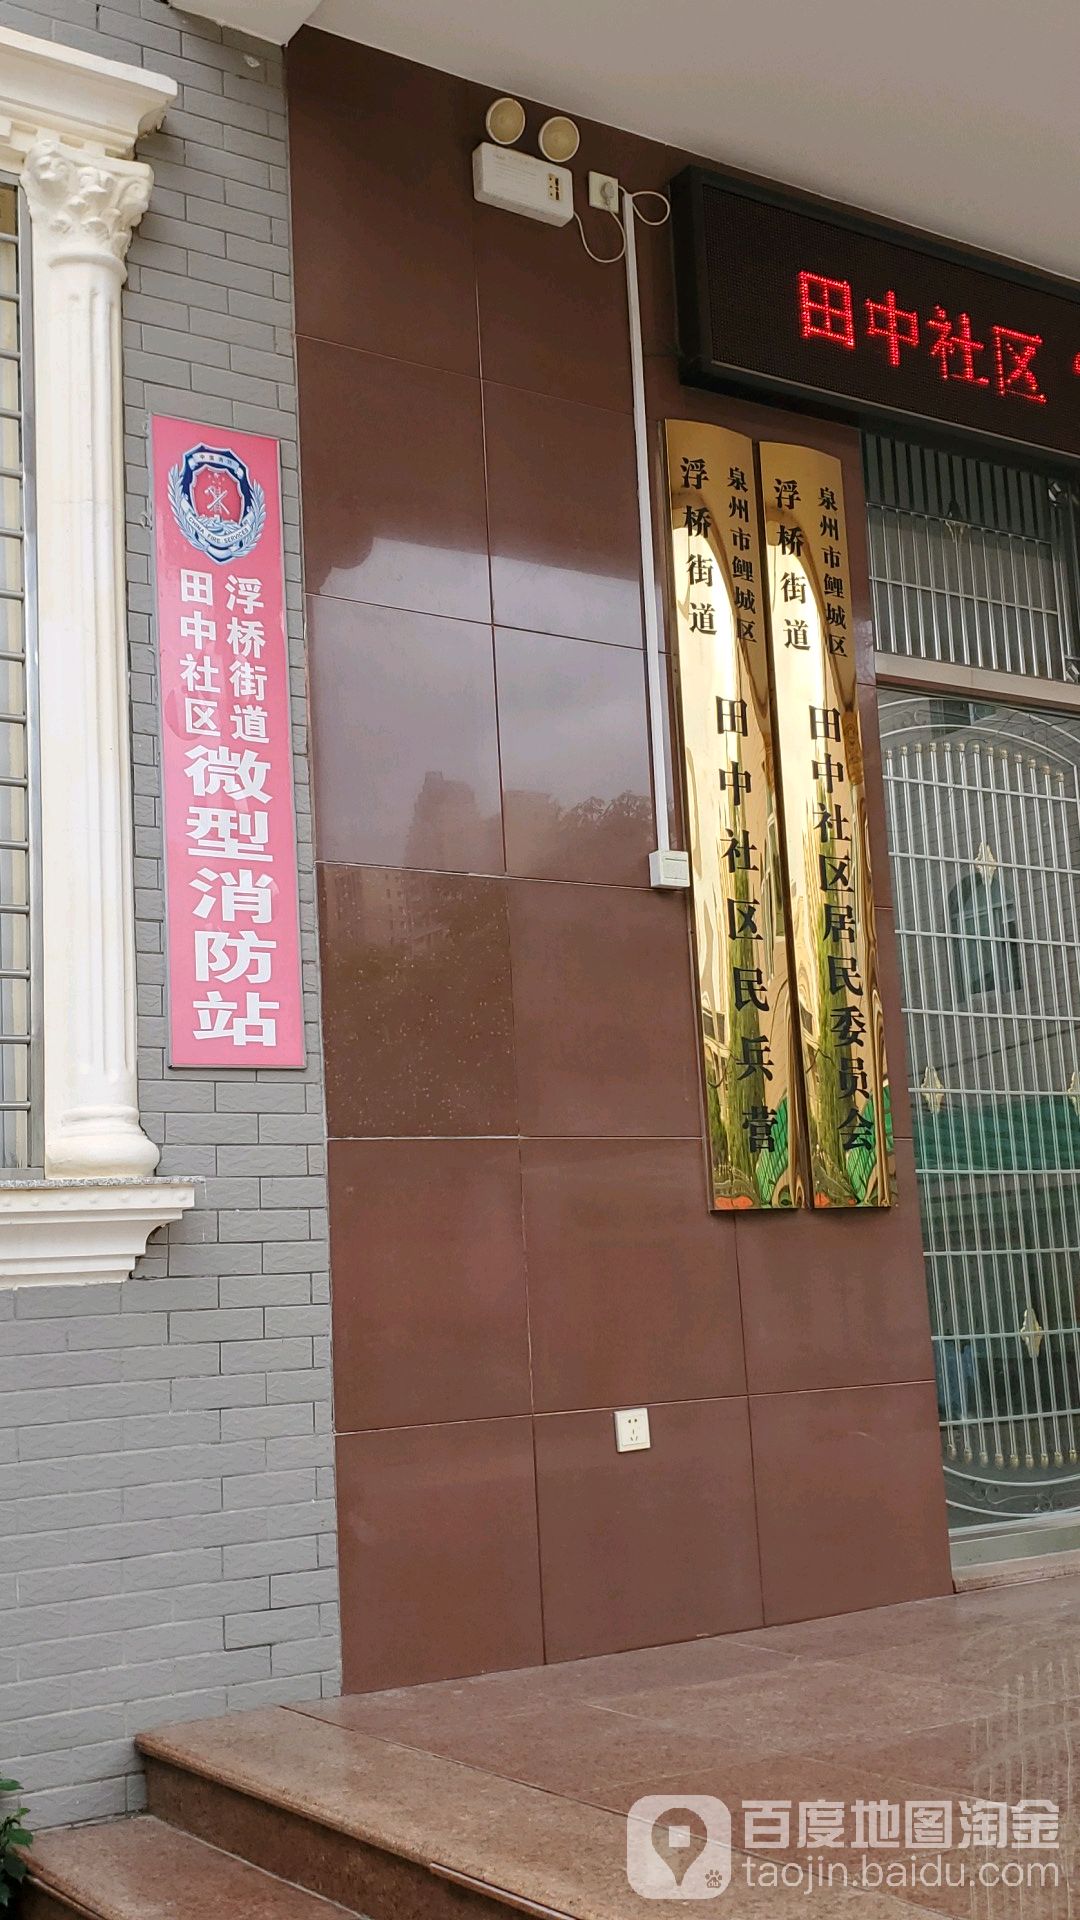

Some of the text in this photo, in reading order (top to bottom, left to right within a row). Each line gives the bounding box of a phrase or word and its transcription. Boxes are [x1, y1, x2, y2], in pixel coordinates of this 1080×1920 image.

[798, 270, 1047, 404] 田中社区
[188, 517, 249, 544] CHINA FIRE SERVICES
[680, 457, 717, 635] 浮桥街道
[727, 466, 757, 643] 泉州市鲤城区
[774, 478, 811, 651] 浮桥街道
[818, 487, 848, 657] 泉州市鲤城区
[179, 568, 222, 737] 田中社区
[224, 574, 270, 744] 浮桥街道
[184, 744, 280, 1047] 微型消防站
[715, 696, 778, 1153] 田中社区民兵营
[808, 704, 875, 1152] 田中社区居民委员会
